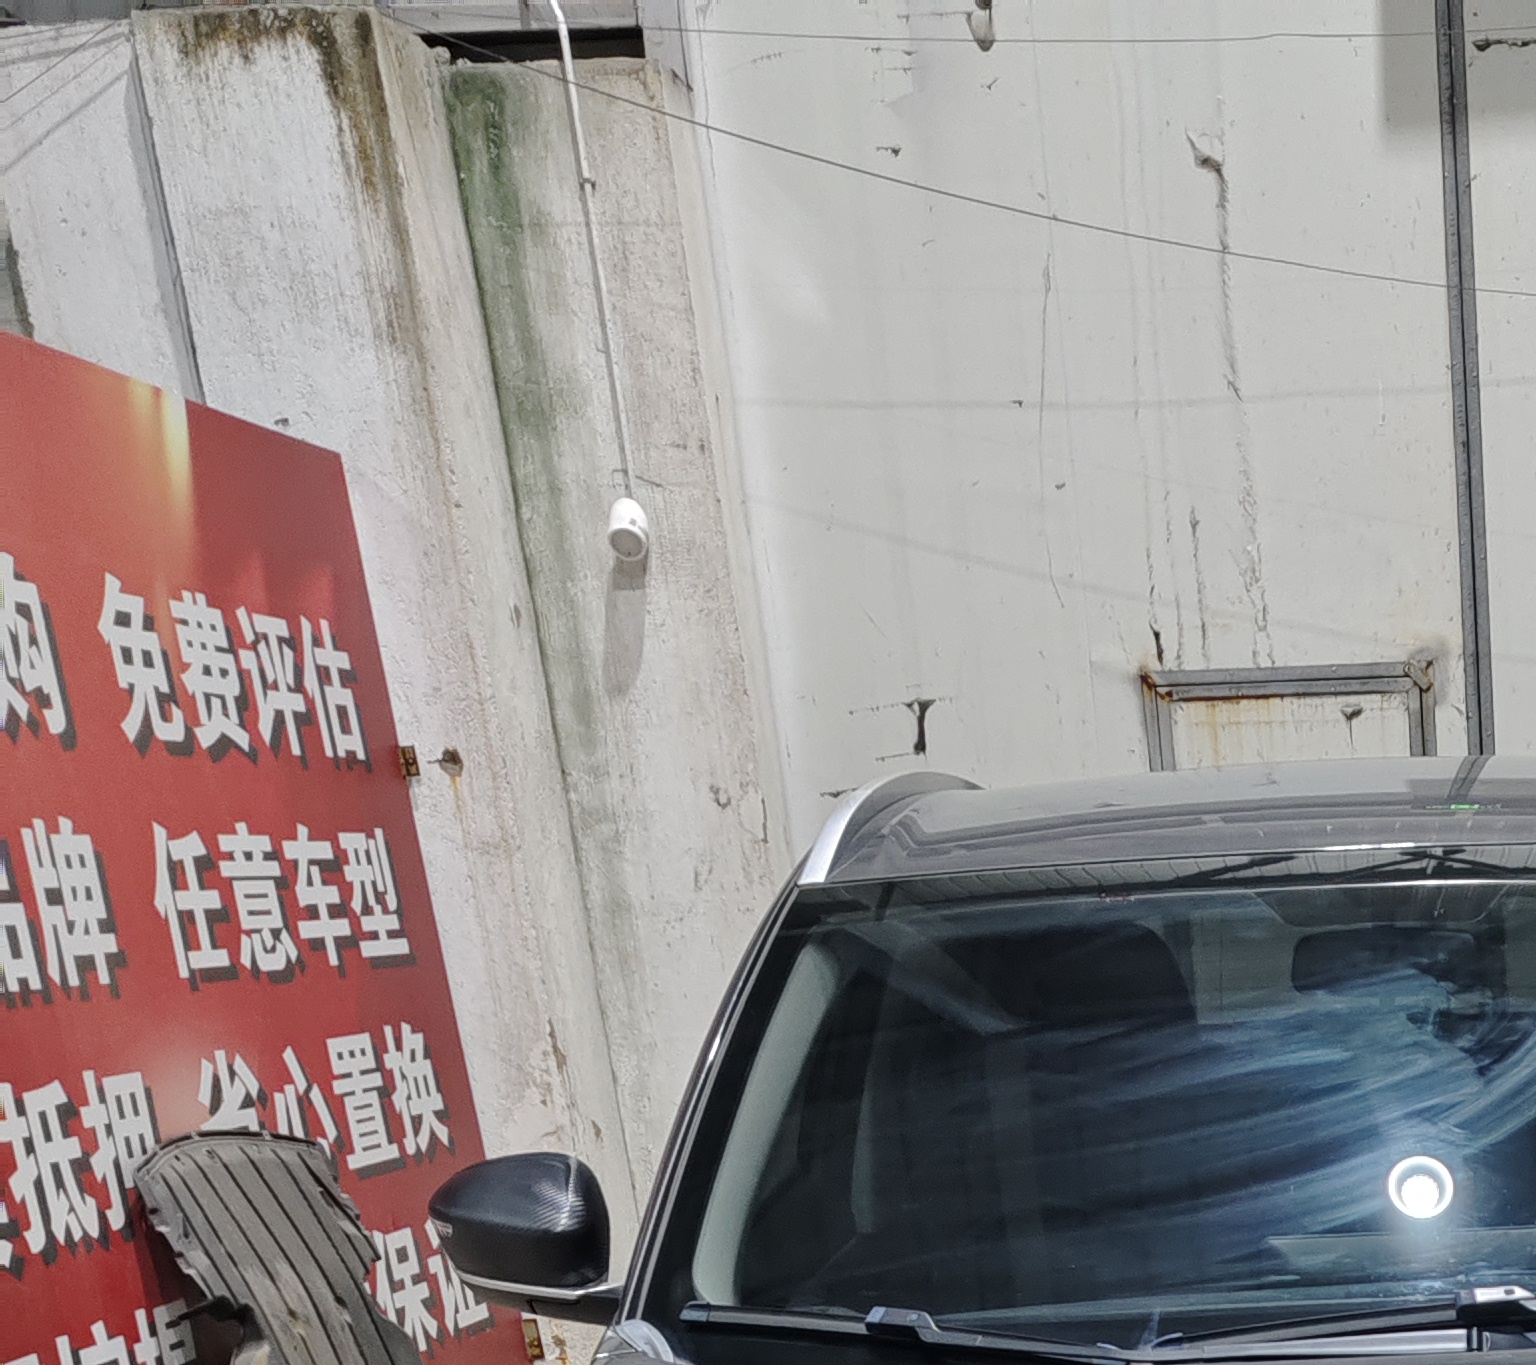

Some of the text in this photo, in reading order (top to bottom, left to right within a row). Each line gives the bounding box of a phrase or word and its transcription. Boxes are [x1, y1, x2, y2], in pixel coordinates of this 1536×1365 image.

[97, 572, 367, 761] 免费评估
[152, 820, 410, 979] 任意车型
[0, 1070, 155, 1268] 抵押
